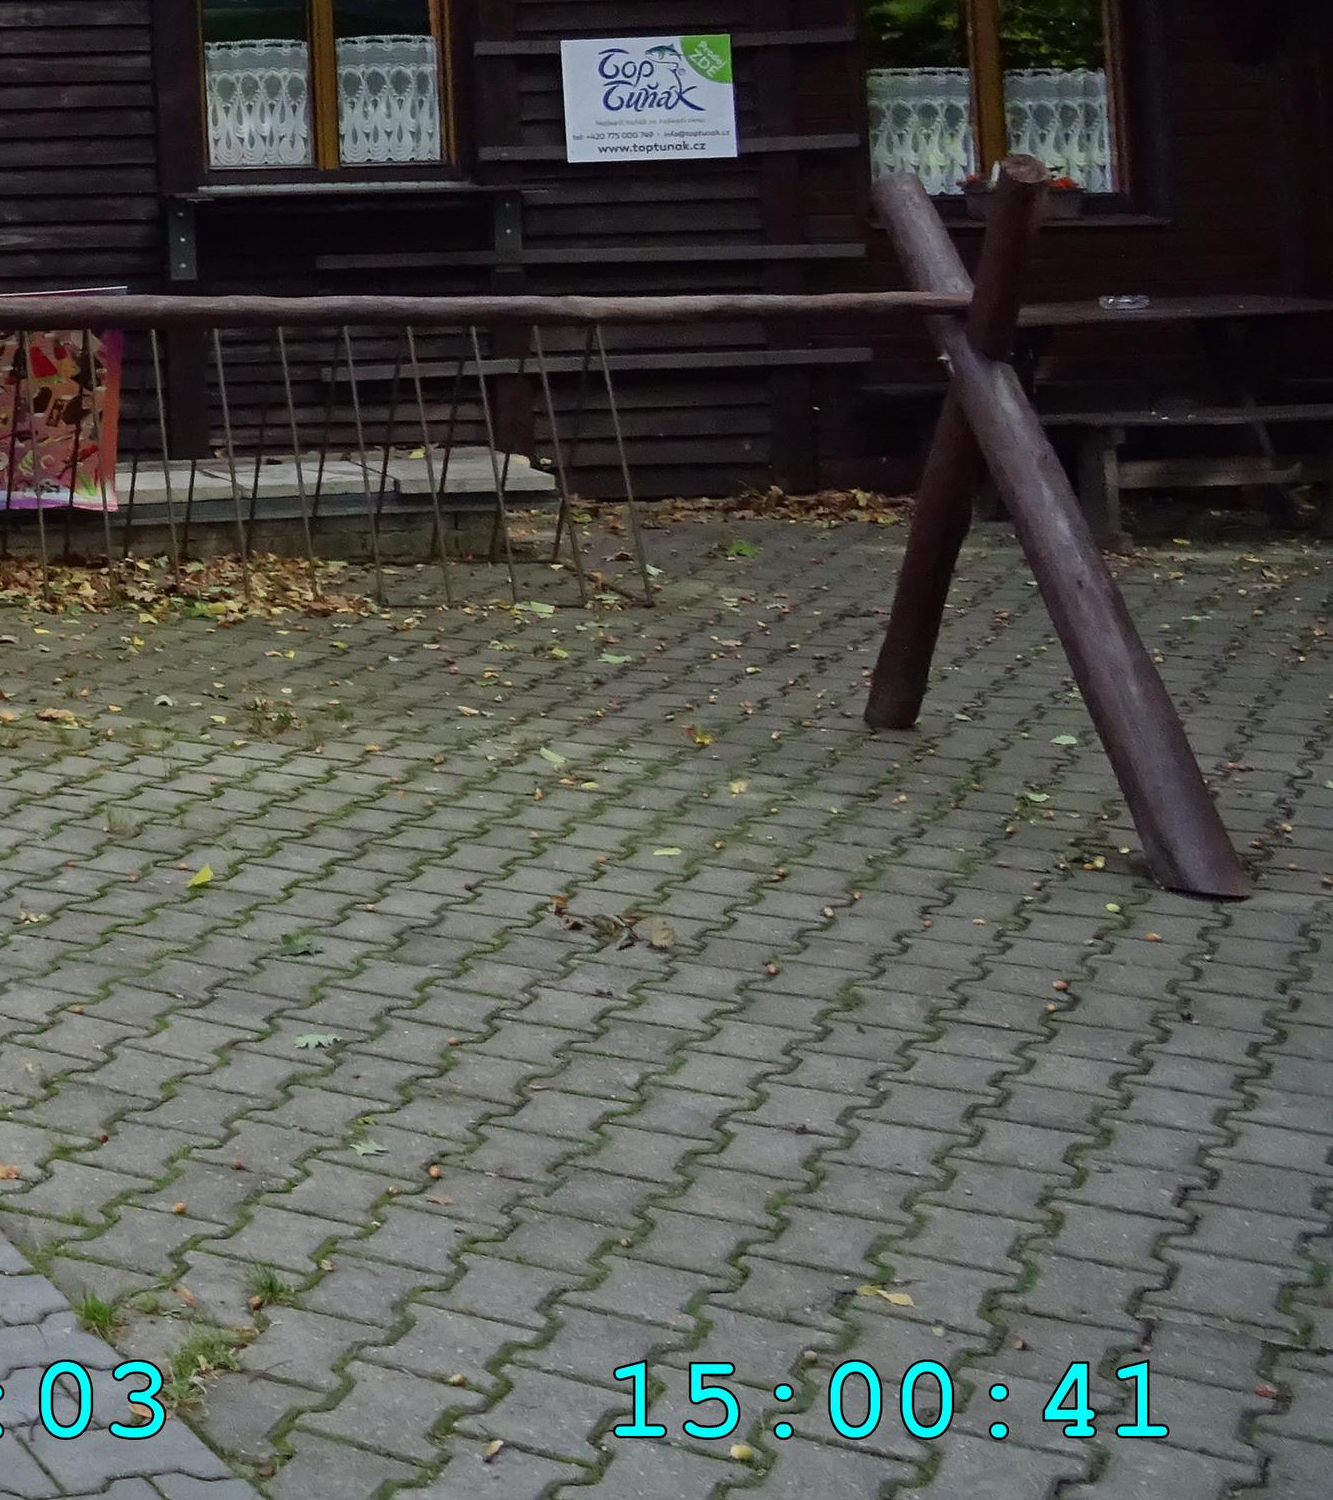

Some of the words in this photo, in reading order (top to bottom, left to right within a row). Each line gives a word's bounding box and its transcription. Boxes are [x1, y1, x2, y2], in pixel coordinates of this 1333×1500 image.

[598, 48, 655, 88] Top
[689, 48, 719, 78] ZDE
[603, 80, 706, 113] Tuňák
[597, 141, 706, 155] www.toptunak.cz
